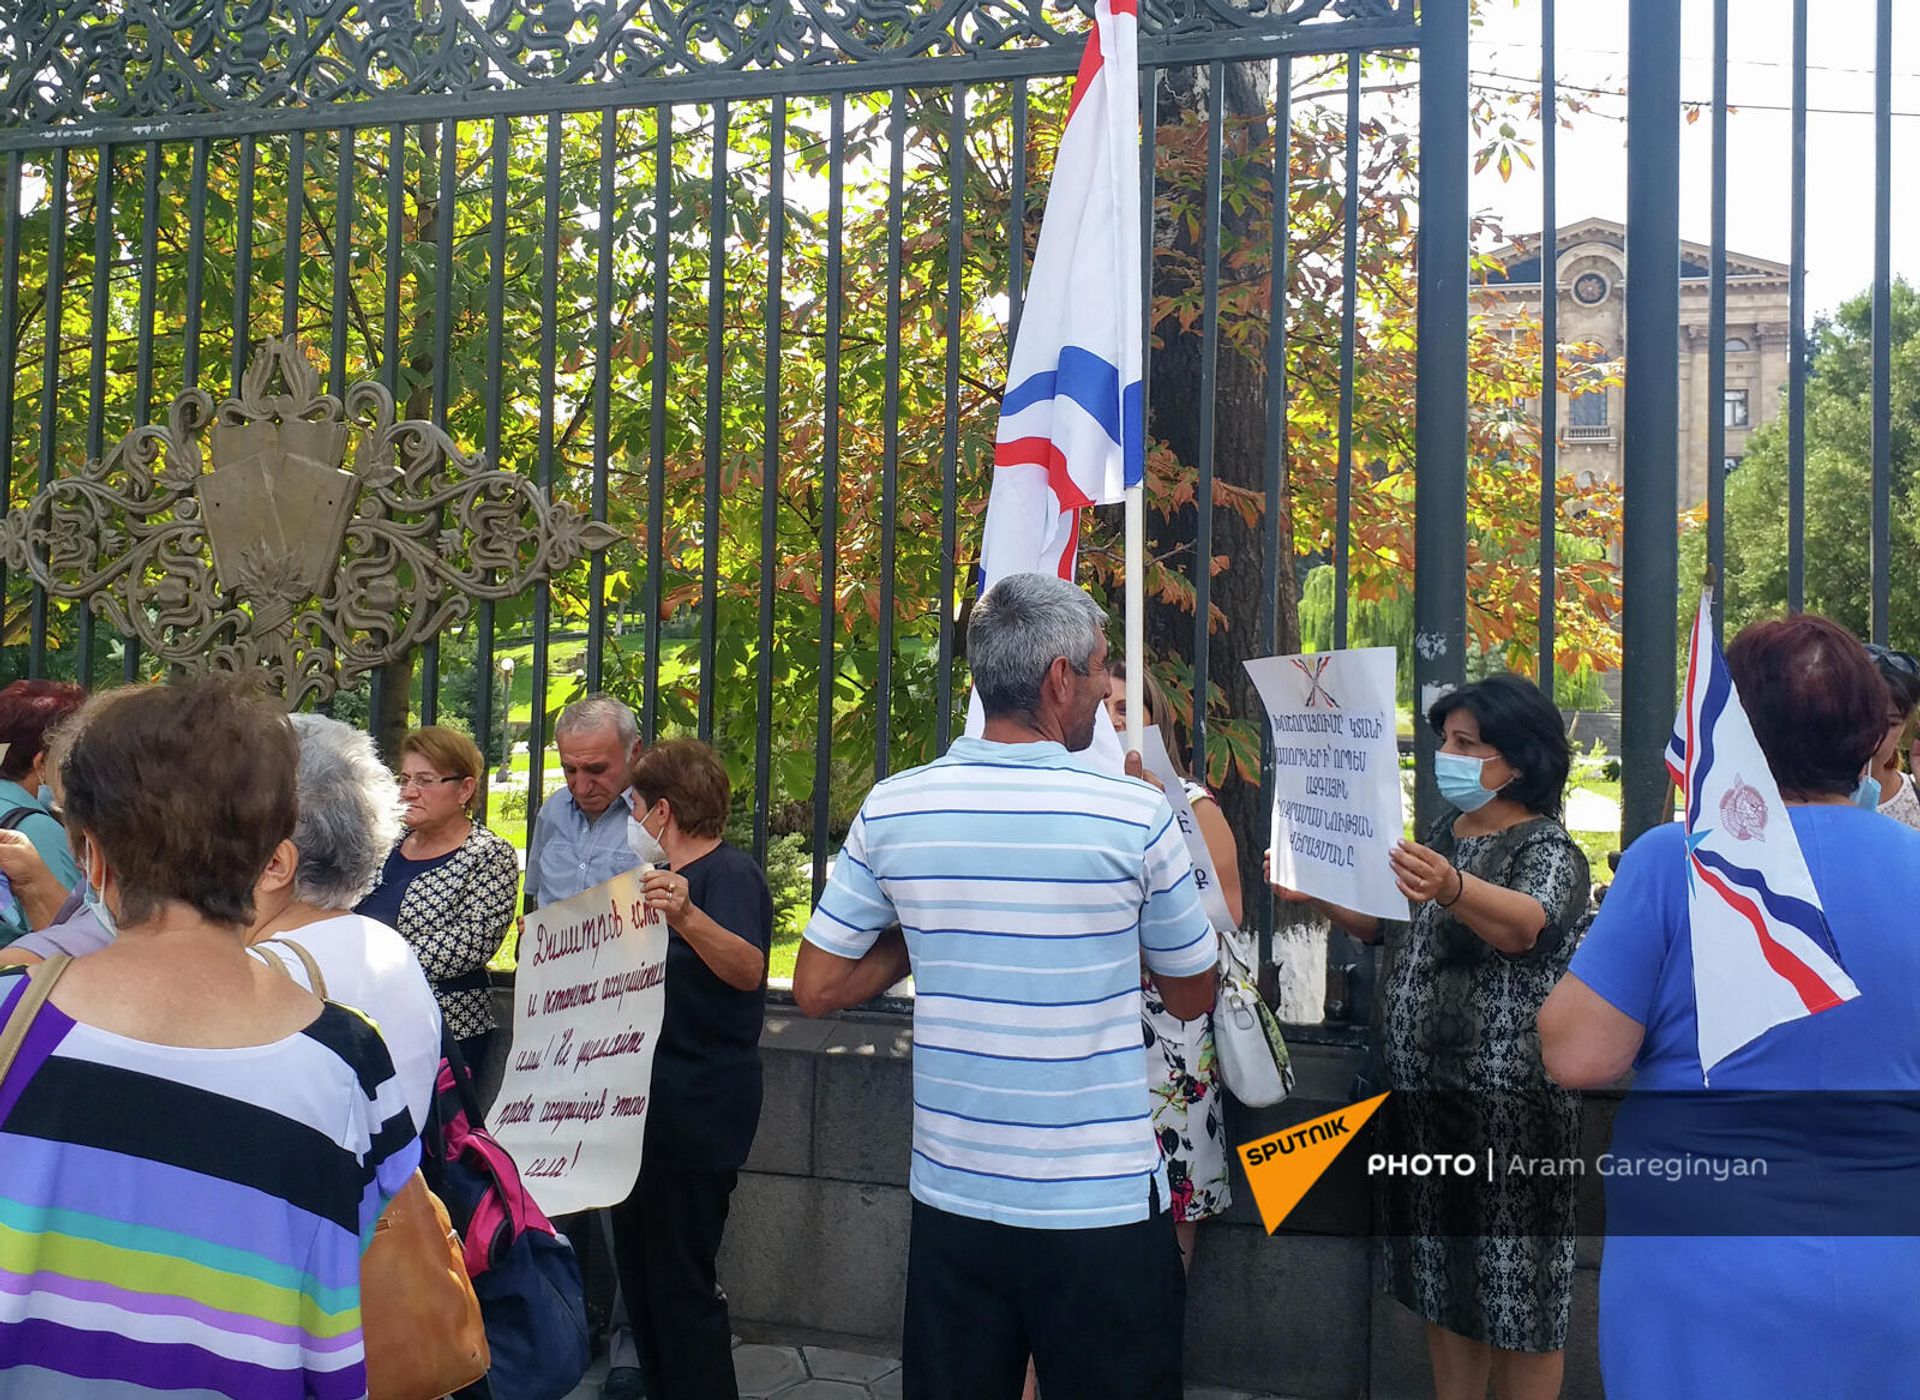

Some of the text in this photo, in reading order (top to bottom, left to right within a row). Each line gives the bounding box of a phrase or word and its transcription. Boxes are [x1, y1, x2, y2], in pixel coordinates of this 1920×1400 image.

[532, 899, 623, 969] Димитров
[527, 993, 538, 1018] и
[553, 1028, 573, 1066] Не
[492, 1093, 535, 1138] права
[610, 1095, 646, 1118] этого
[524, 1140, 583, 1178] села!
